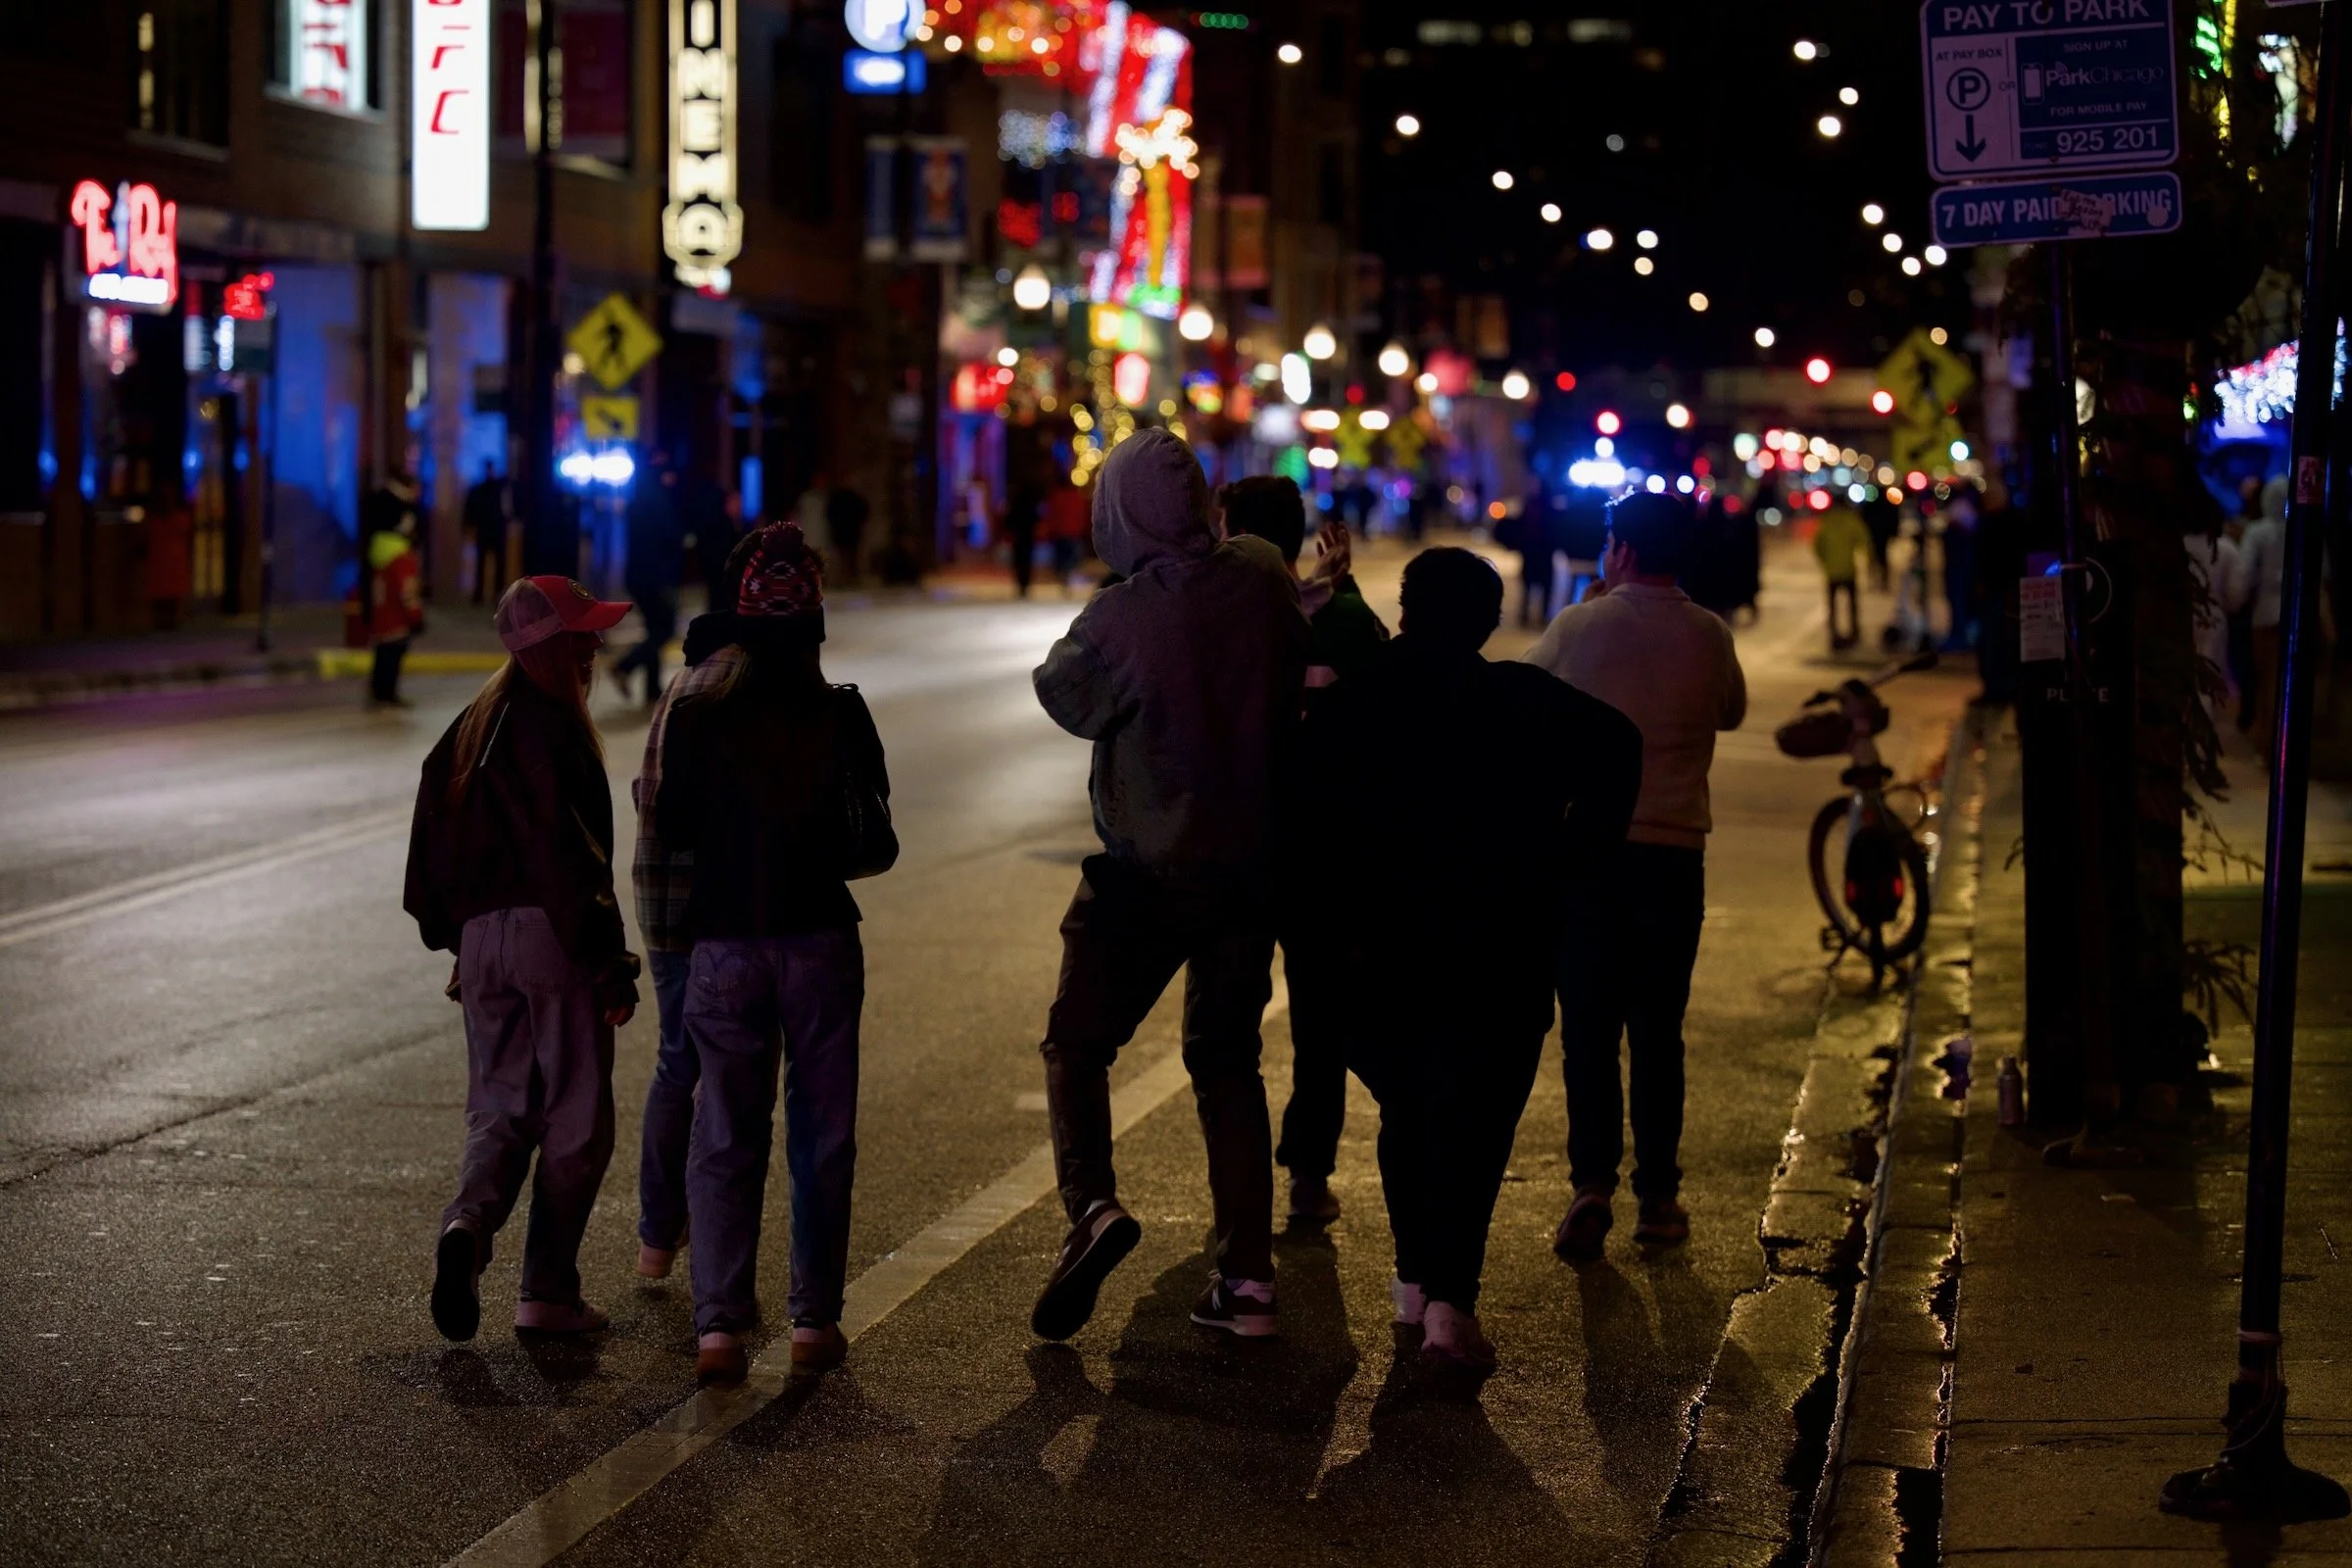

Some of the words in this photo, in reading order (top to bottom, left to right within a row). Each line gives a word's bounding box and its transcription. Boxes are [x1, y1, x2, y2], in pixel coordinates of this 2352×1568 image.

[1943, 4, 2001, 31] PAY
[2010, 2, 2054, 26] TO
[2064, 0, 2150, 24] PARK
[2063, 41, 2092, 53] SIGN
[2095, 40, 2112, 51] UP
[2113, 38, 2129, 50] AT
[1936, 50, 1952, 62] AT
[1953, 49, 1977, 61] PAY
[1978, 48, 2003, 59] BOX
[1998, 81, 2016, 92] OR
[2050, 106, 2075, 118] FOR
[2077, 103, 2123, 116] MOBILE
[2126, 101, 2148, 114] PAY
[2056, 128, 2105, 154] 925
[2113, 125, 2158, 151] 201
[1941, 204, 1957, 229] 7
[1963, 199, 2006, 227] DAY
[2013, 195, 2069, 223] PAID
[2078, 188, 2173, 219] RKING
[2045, 686, 2110, 705] PLE
